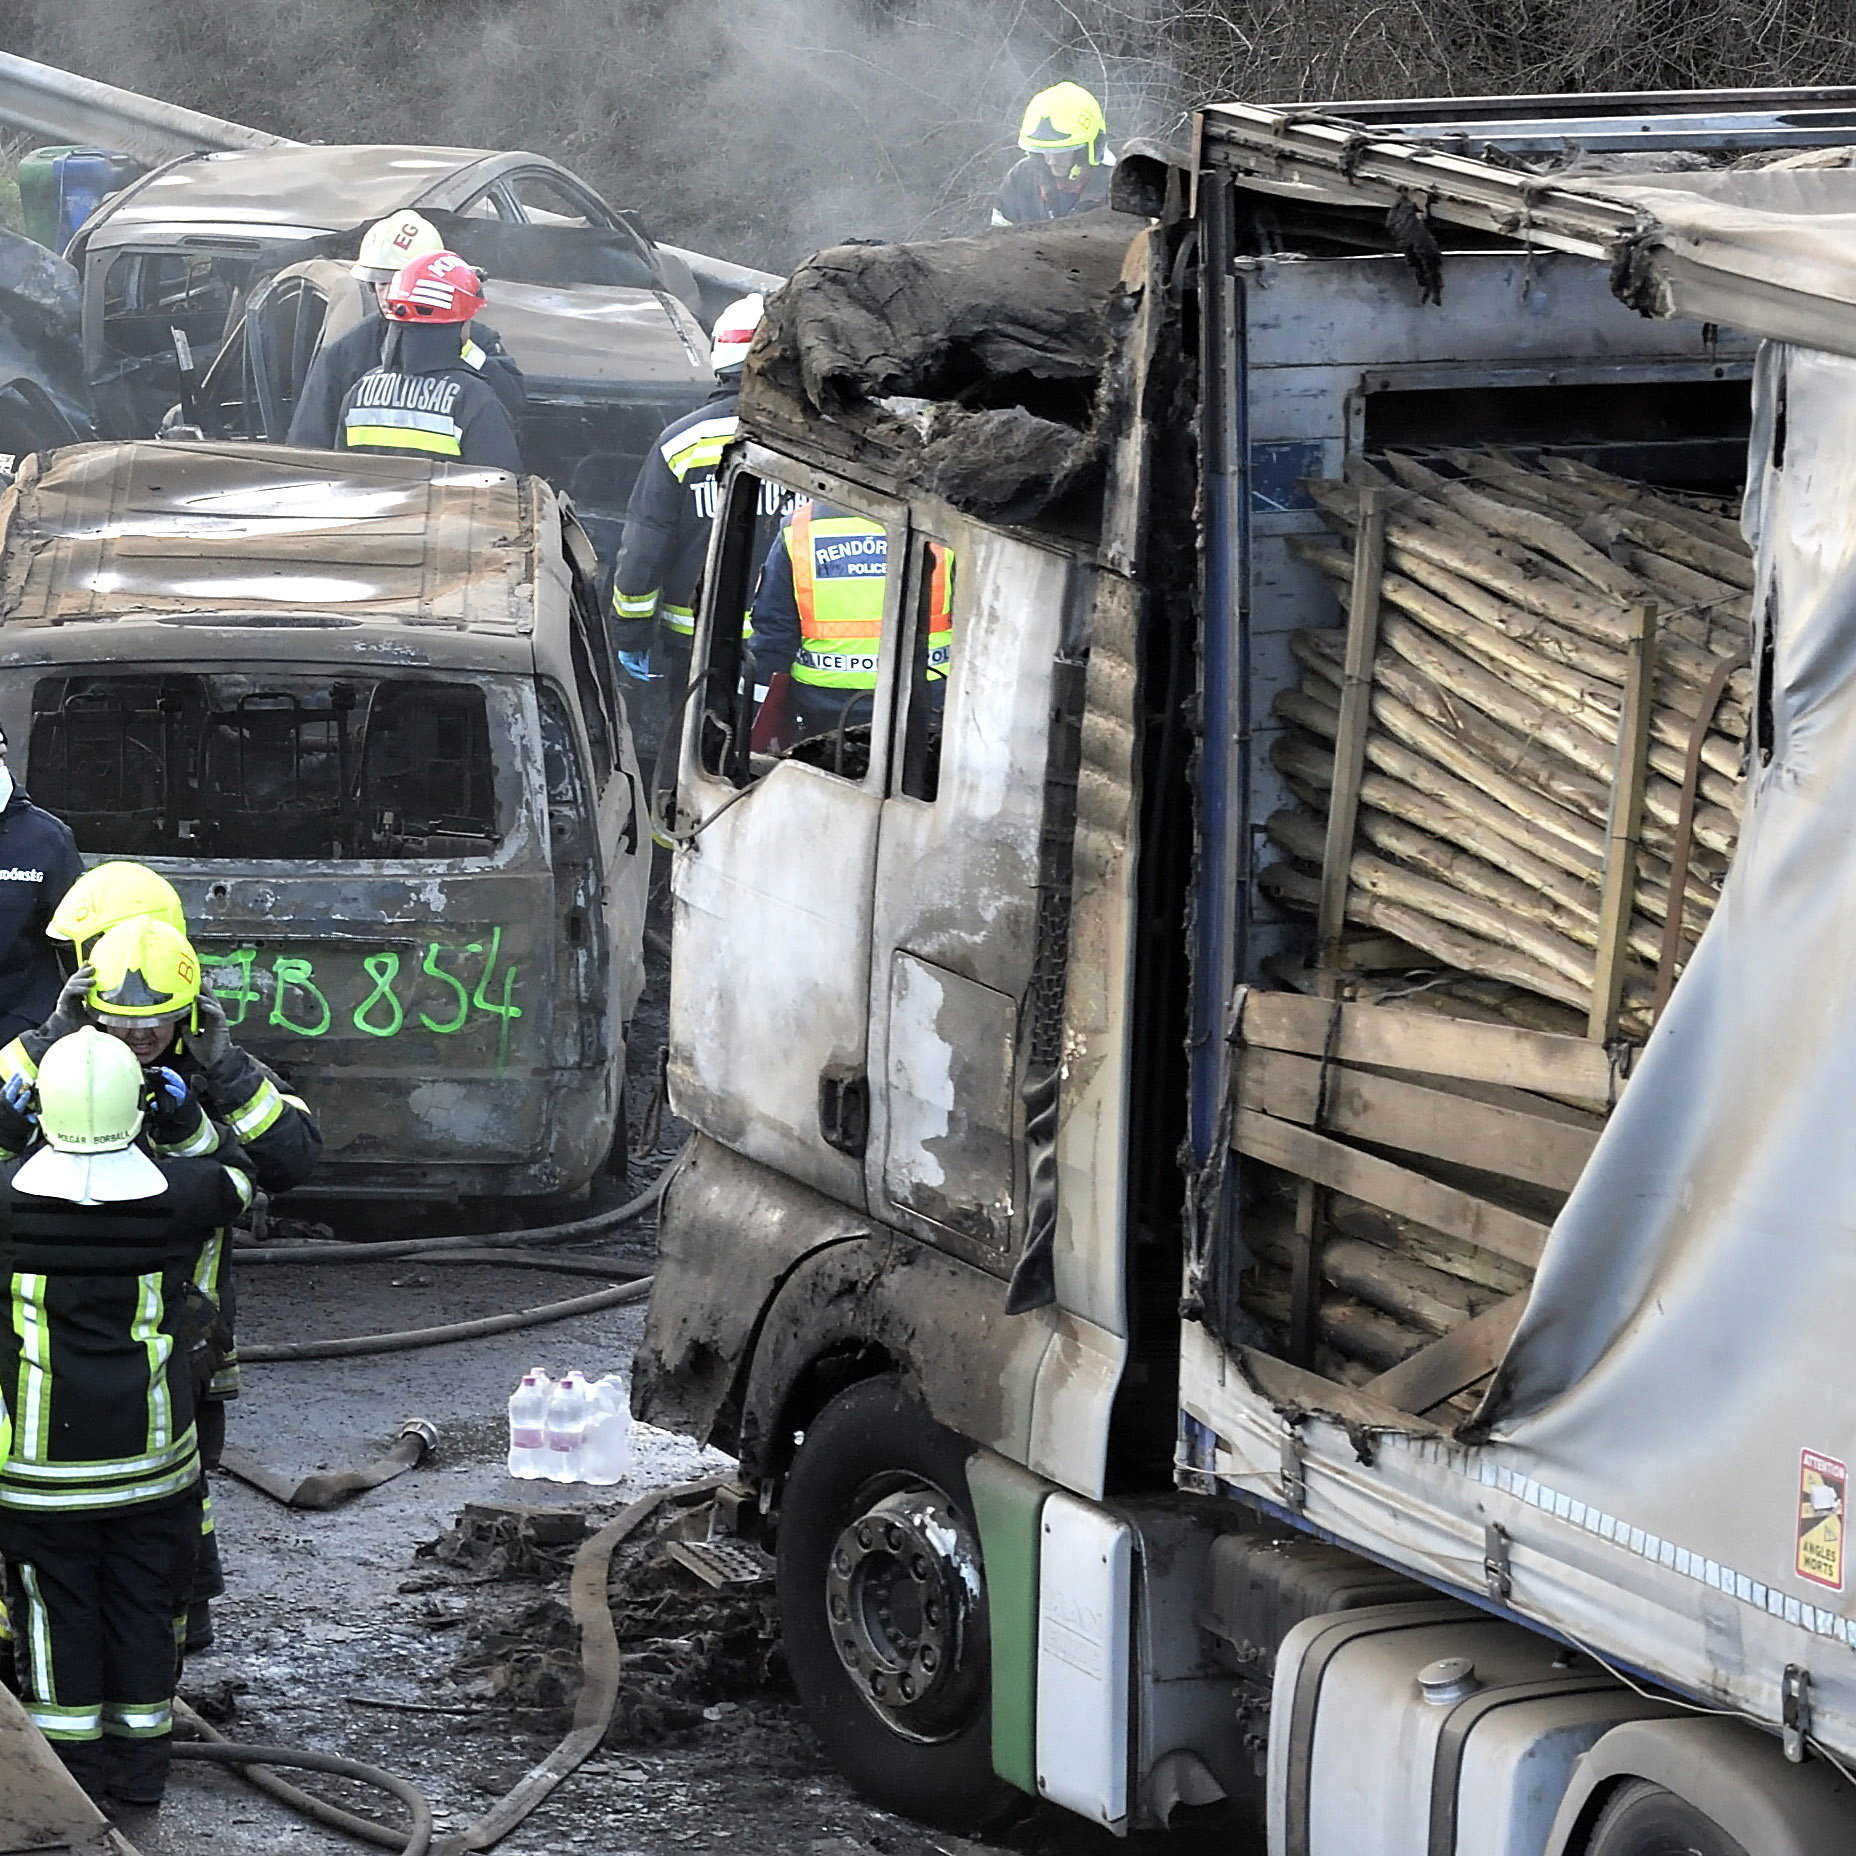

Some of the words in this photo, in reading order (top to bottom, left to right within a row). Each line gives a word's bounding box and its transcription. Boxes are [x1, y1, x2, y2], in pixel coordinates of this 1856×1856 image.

[392, 223, 419, 251] EG
[816, 536, 887, 565] RENDŐR
[178, 951, 195, 985] BI
[1803, 1542, 1837, 1563] ANGLES
[1803, 1555, 1834, 1577] MORTS
